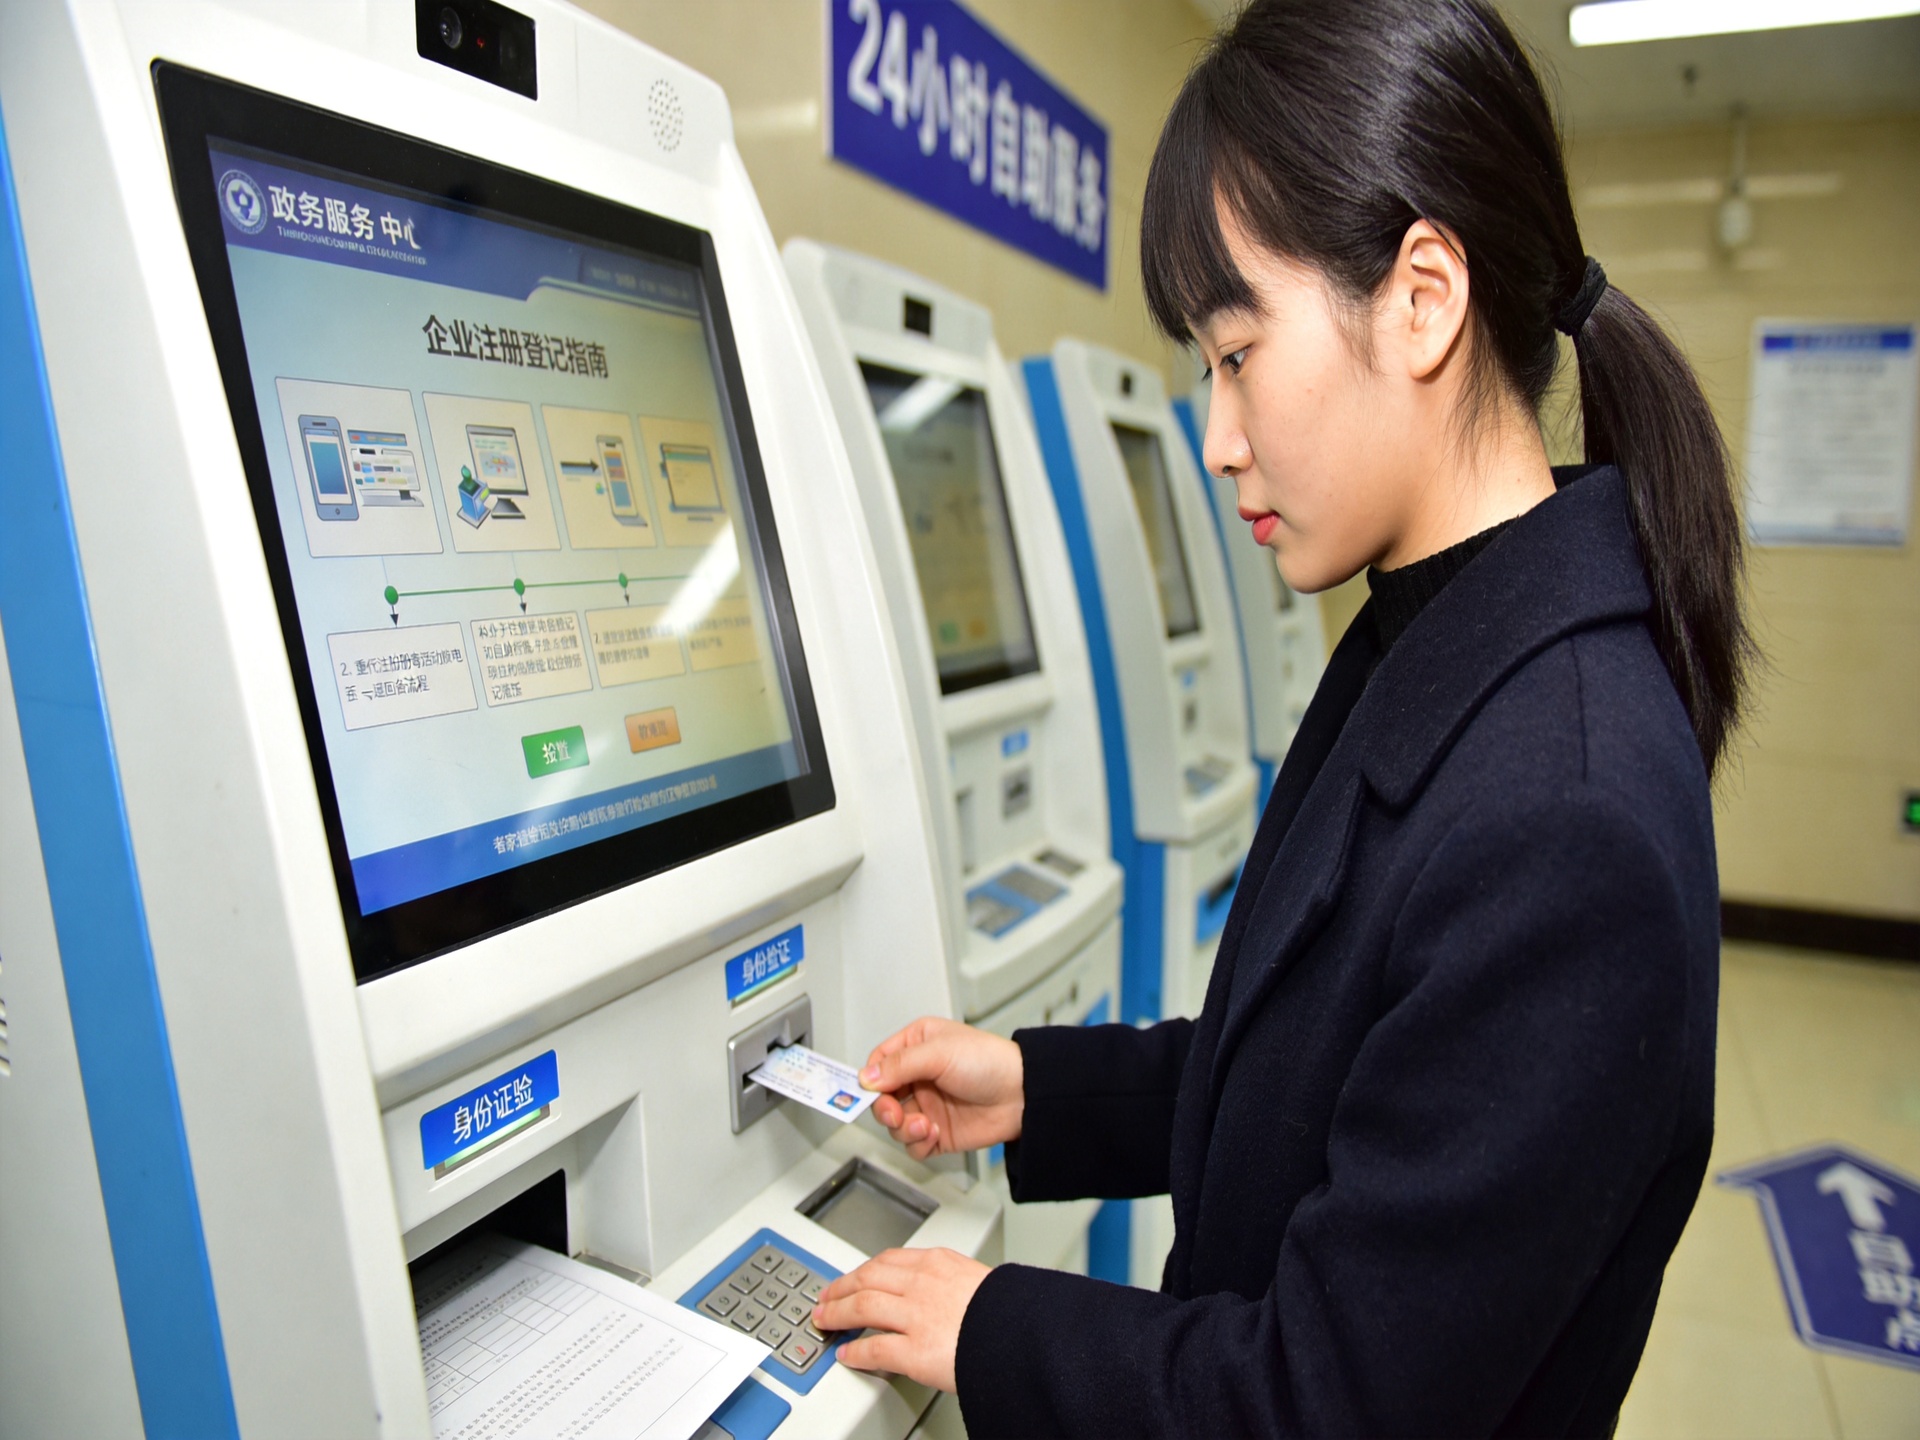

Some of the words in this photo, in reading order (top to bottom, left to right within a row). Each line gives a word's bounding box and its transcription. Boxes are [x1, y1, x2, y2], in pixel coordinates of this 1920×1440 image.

[268, 185, 375, 241] 政务服务
[422, 314, 609, 378] 企业注册登记指南
[743, 938, 791, 987] 身份验证
[453, 1073, 534, 1145] 身份证验
